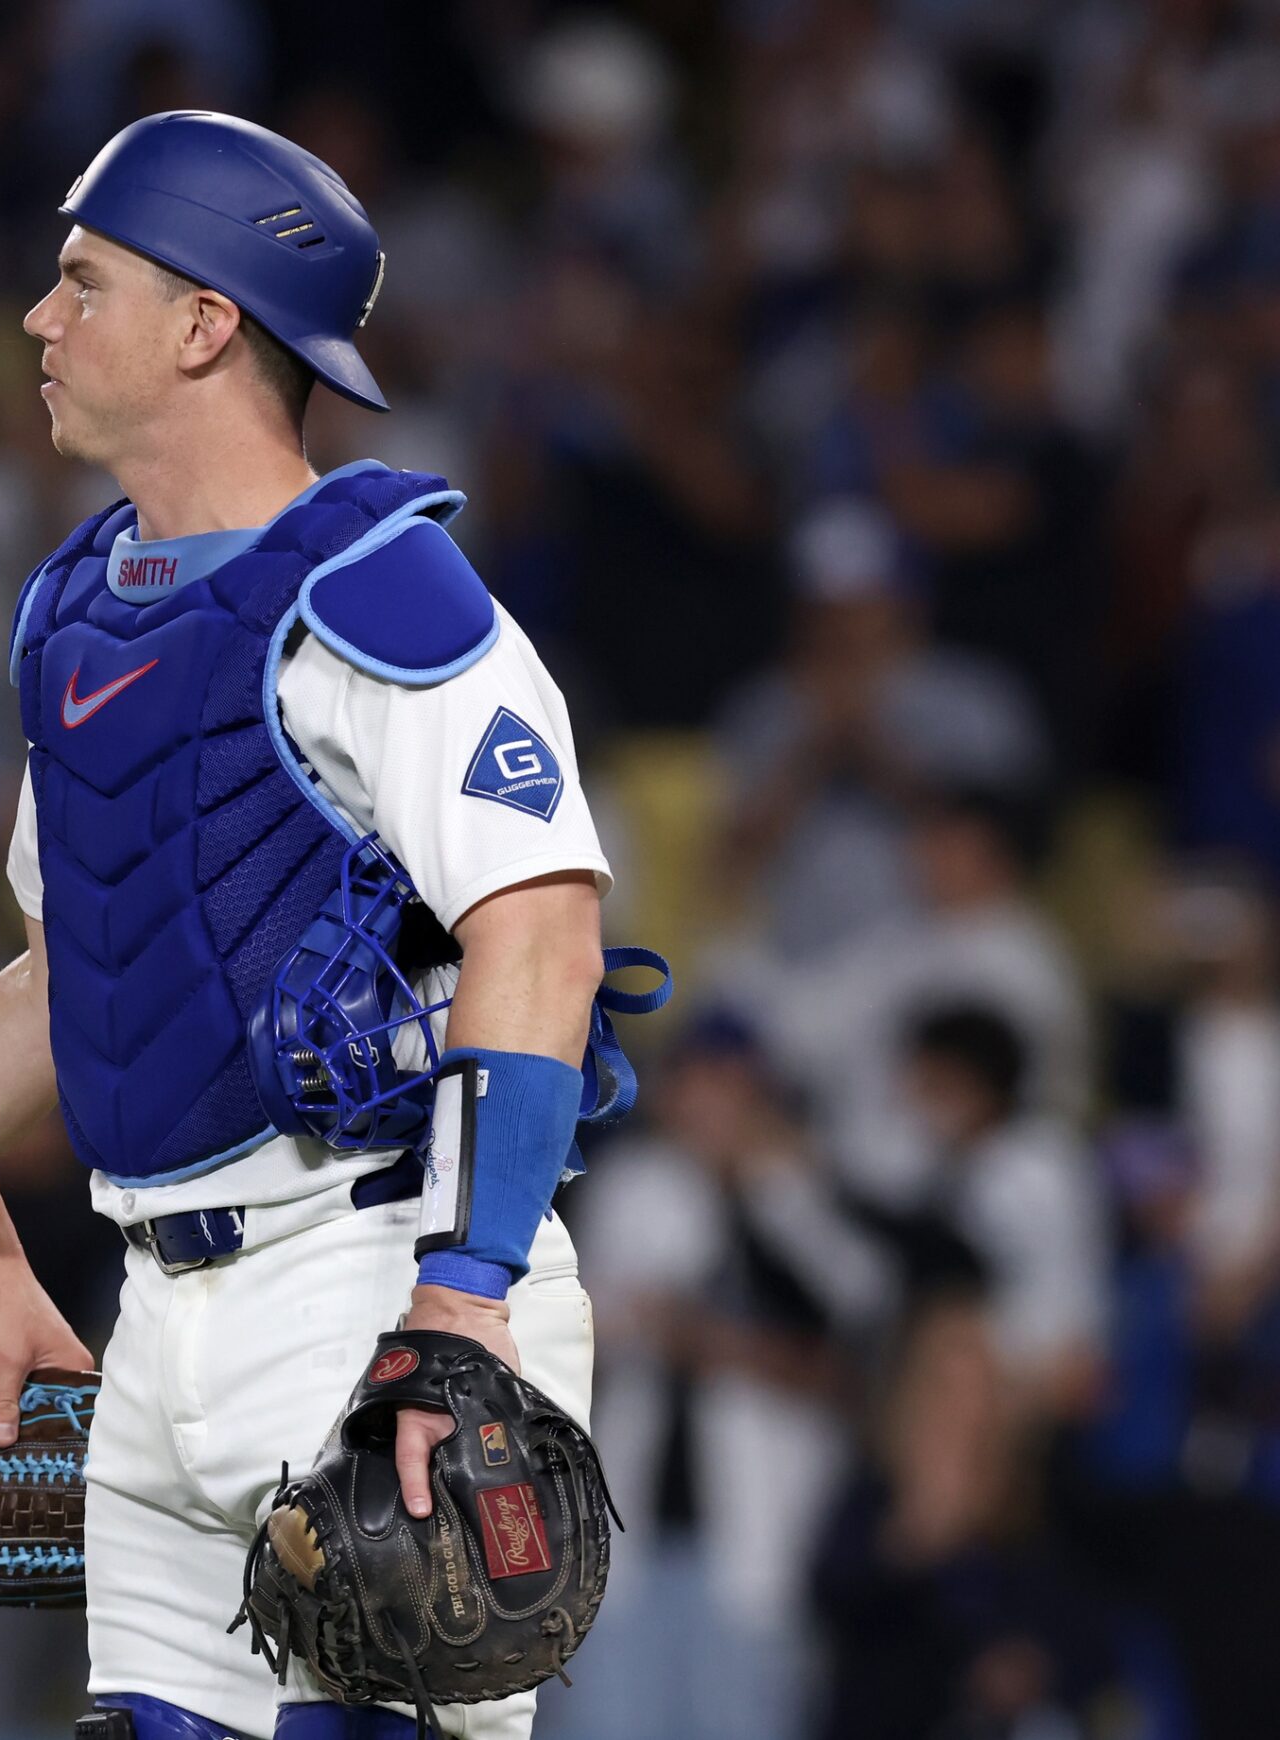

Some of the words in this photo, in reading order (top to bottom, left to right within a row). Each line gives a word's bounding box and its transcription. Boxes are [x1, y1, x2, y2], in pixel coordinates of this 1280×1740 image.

[118, 557, 178, 587] SMITH
[493, 739, 542, 780] G
[497, 777, 558, 796] GUGGENHEIM
[440, 1524, 454, 1559] GLOVE
[495, 1494, 530, 1565] Rawlings
[446, 1561, 459, 1593] GOLD
[451, 1594, 465, 1618] THE
